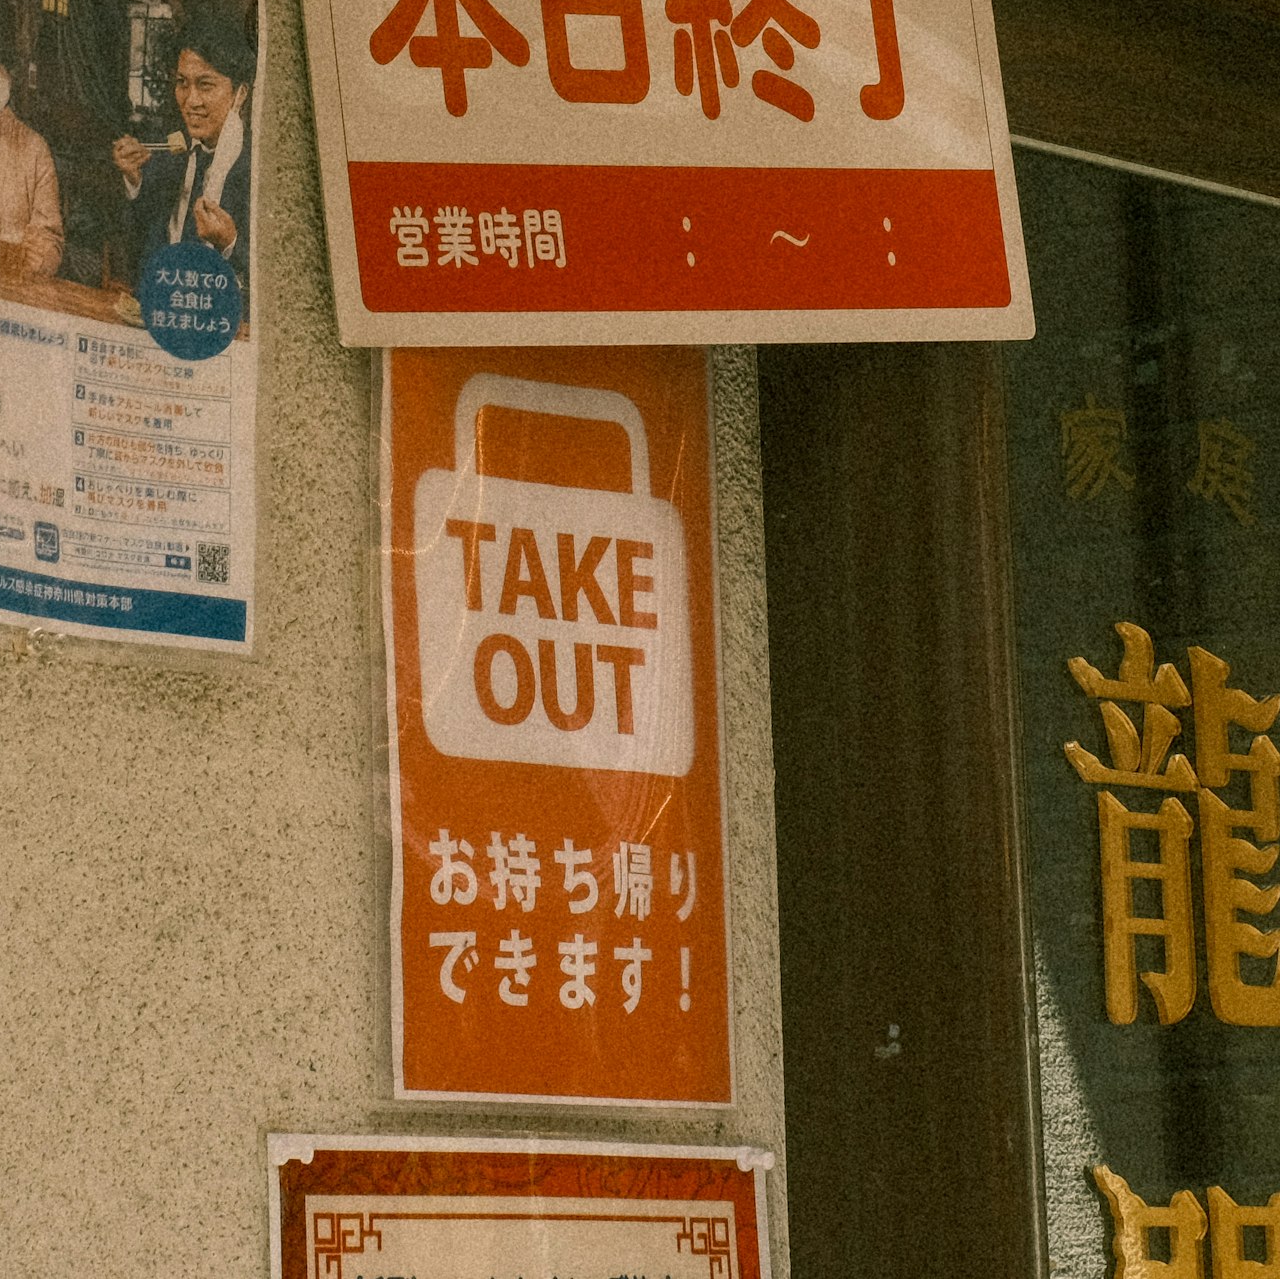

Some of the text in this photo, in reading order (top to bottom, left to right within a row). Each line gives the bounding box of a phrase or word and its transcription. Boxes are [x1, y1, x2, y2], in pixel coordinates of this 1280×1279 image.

[389, 205, 568, 269] 営業時間
[155, 267, 228, 290] 大人数での
[169, 291, 213, 310] 会食は
[151, 310, 232, 334] 控えましょう
[444, 518, 659, 631] TAKE
[473, 632, 646, 736] OUT
[428, 828, 697, 923] お持ち帰り
[428, 929, 693, 1014] できます!
